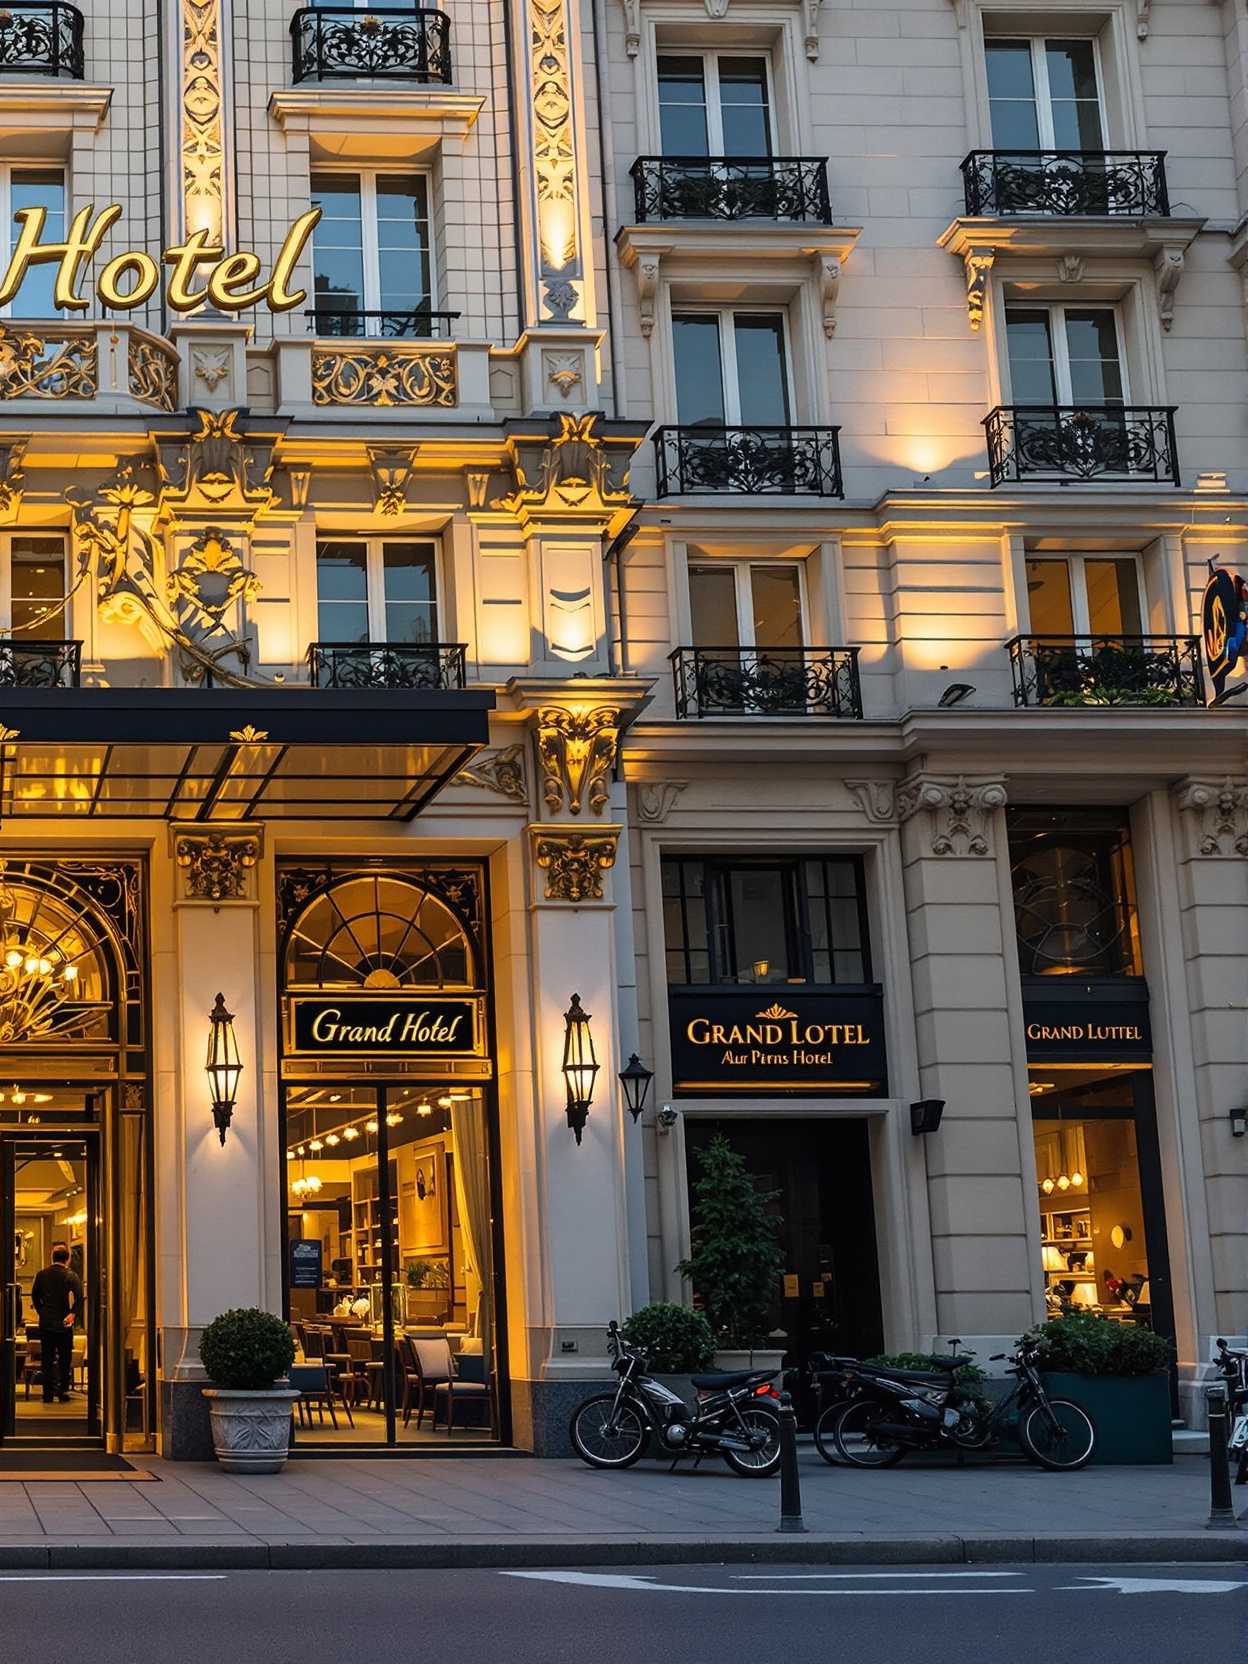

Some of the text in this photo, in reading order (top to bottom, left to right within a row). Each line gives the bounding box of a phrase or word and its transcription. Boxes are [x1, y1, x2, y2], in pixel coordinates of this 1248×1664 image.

[312, 1009, 463, 1042] Grand Hotel
[687, 1018, 783, 1045] GRAND
[1027, 1023, 1084, 1040] GRAND
